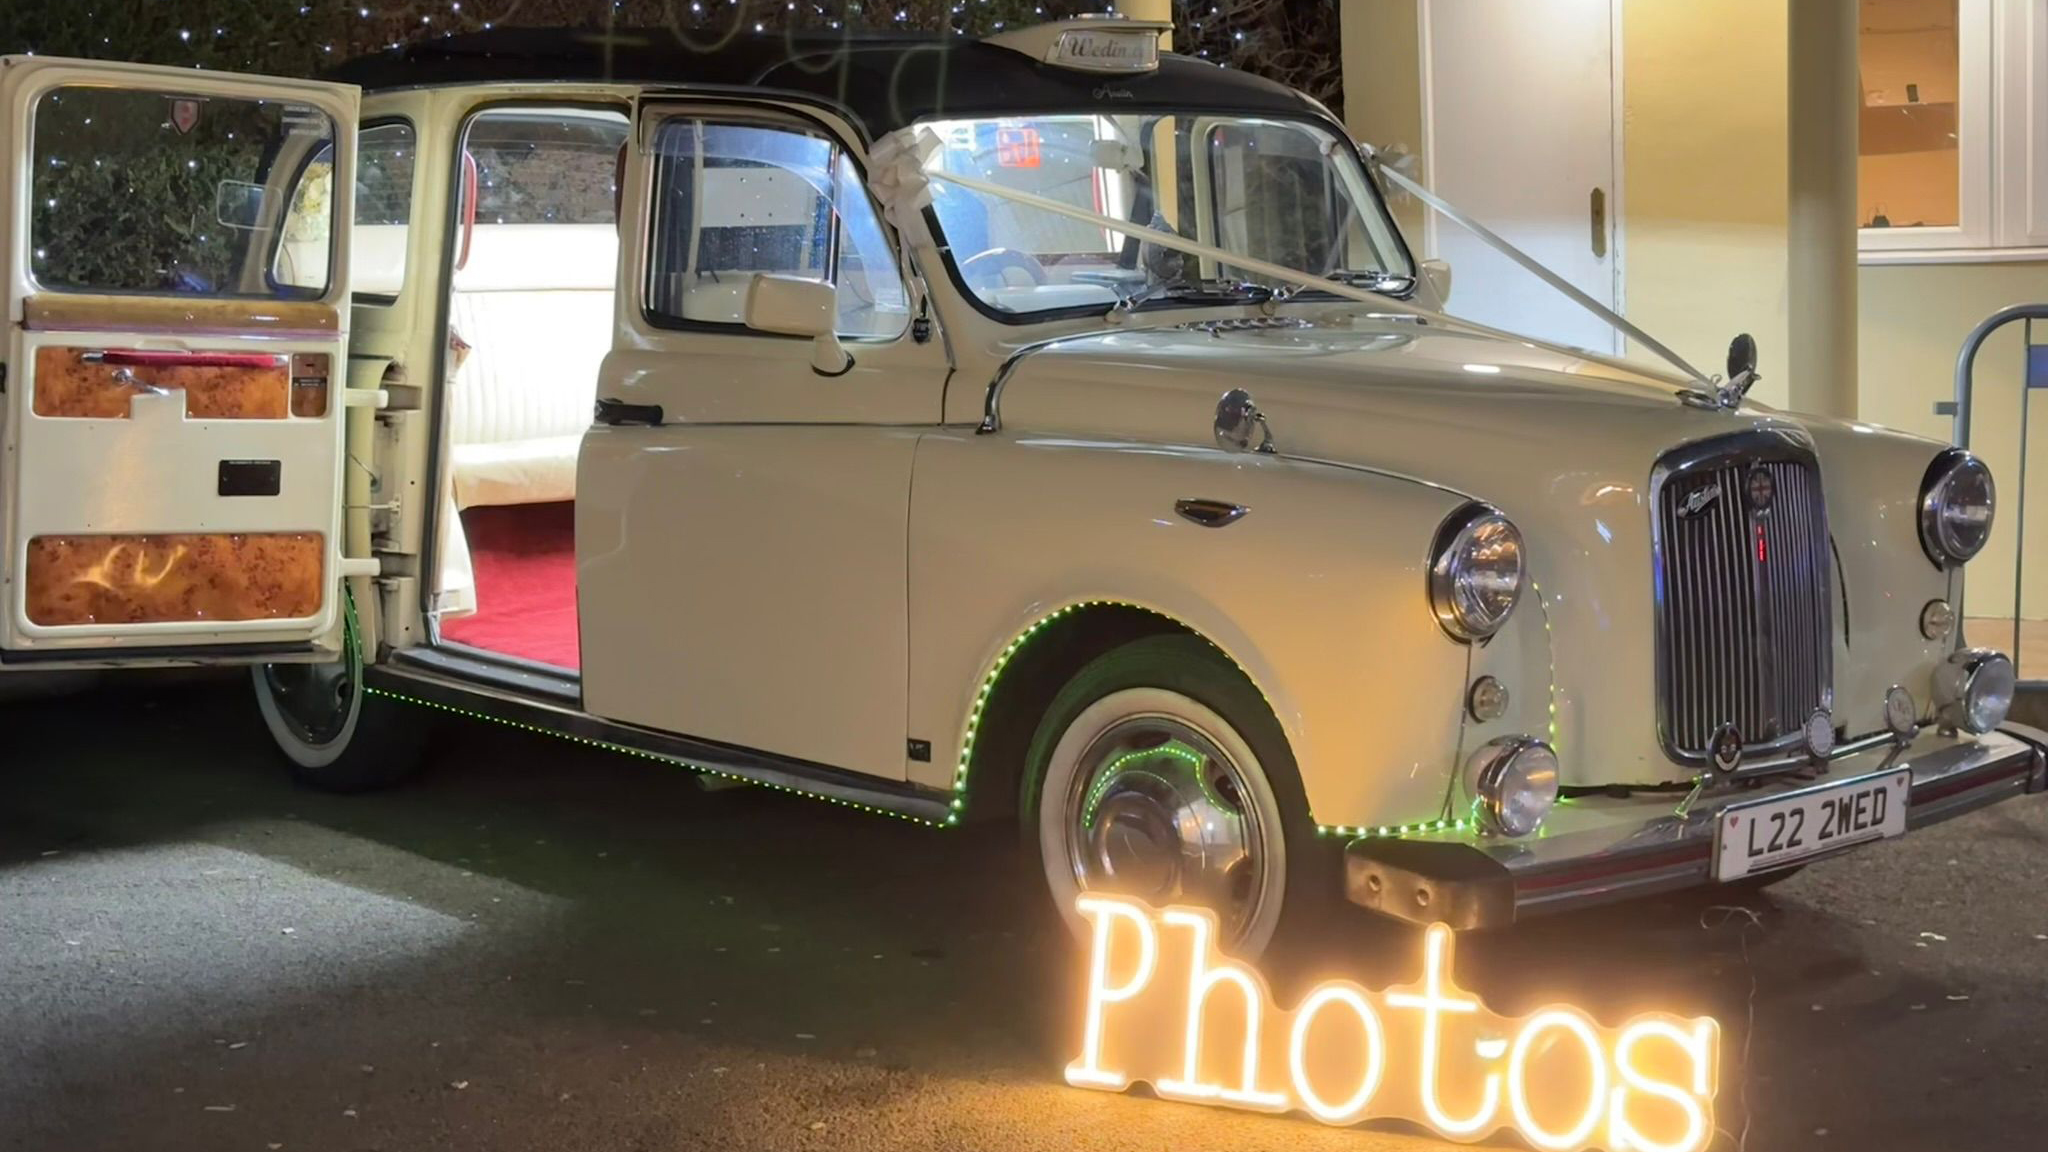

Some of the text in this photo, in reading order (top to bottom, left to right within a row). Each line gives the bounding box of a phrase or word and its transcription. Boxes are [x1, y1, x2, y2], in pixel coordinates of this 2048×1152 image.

[1747, 786, 1888, 858] L22 2WED
[1065, 898, 1714, 1152] Photos
